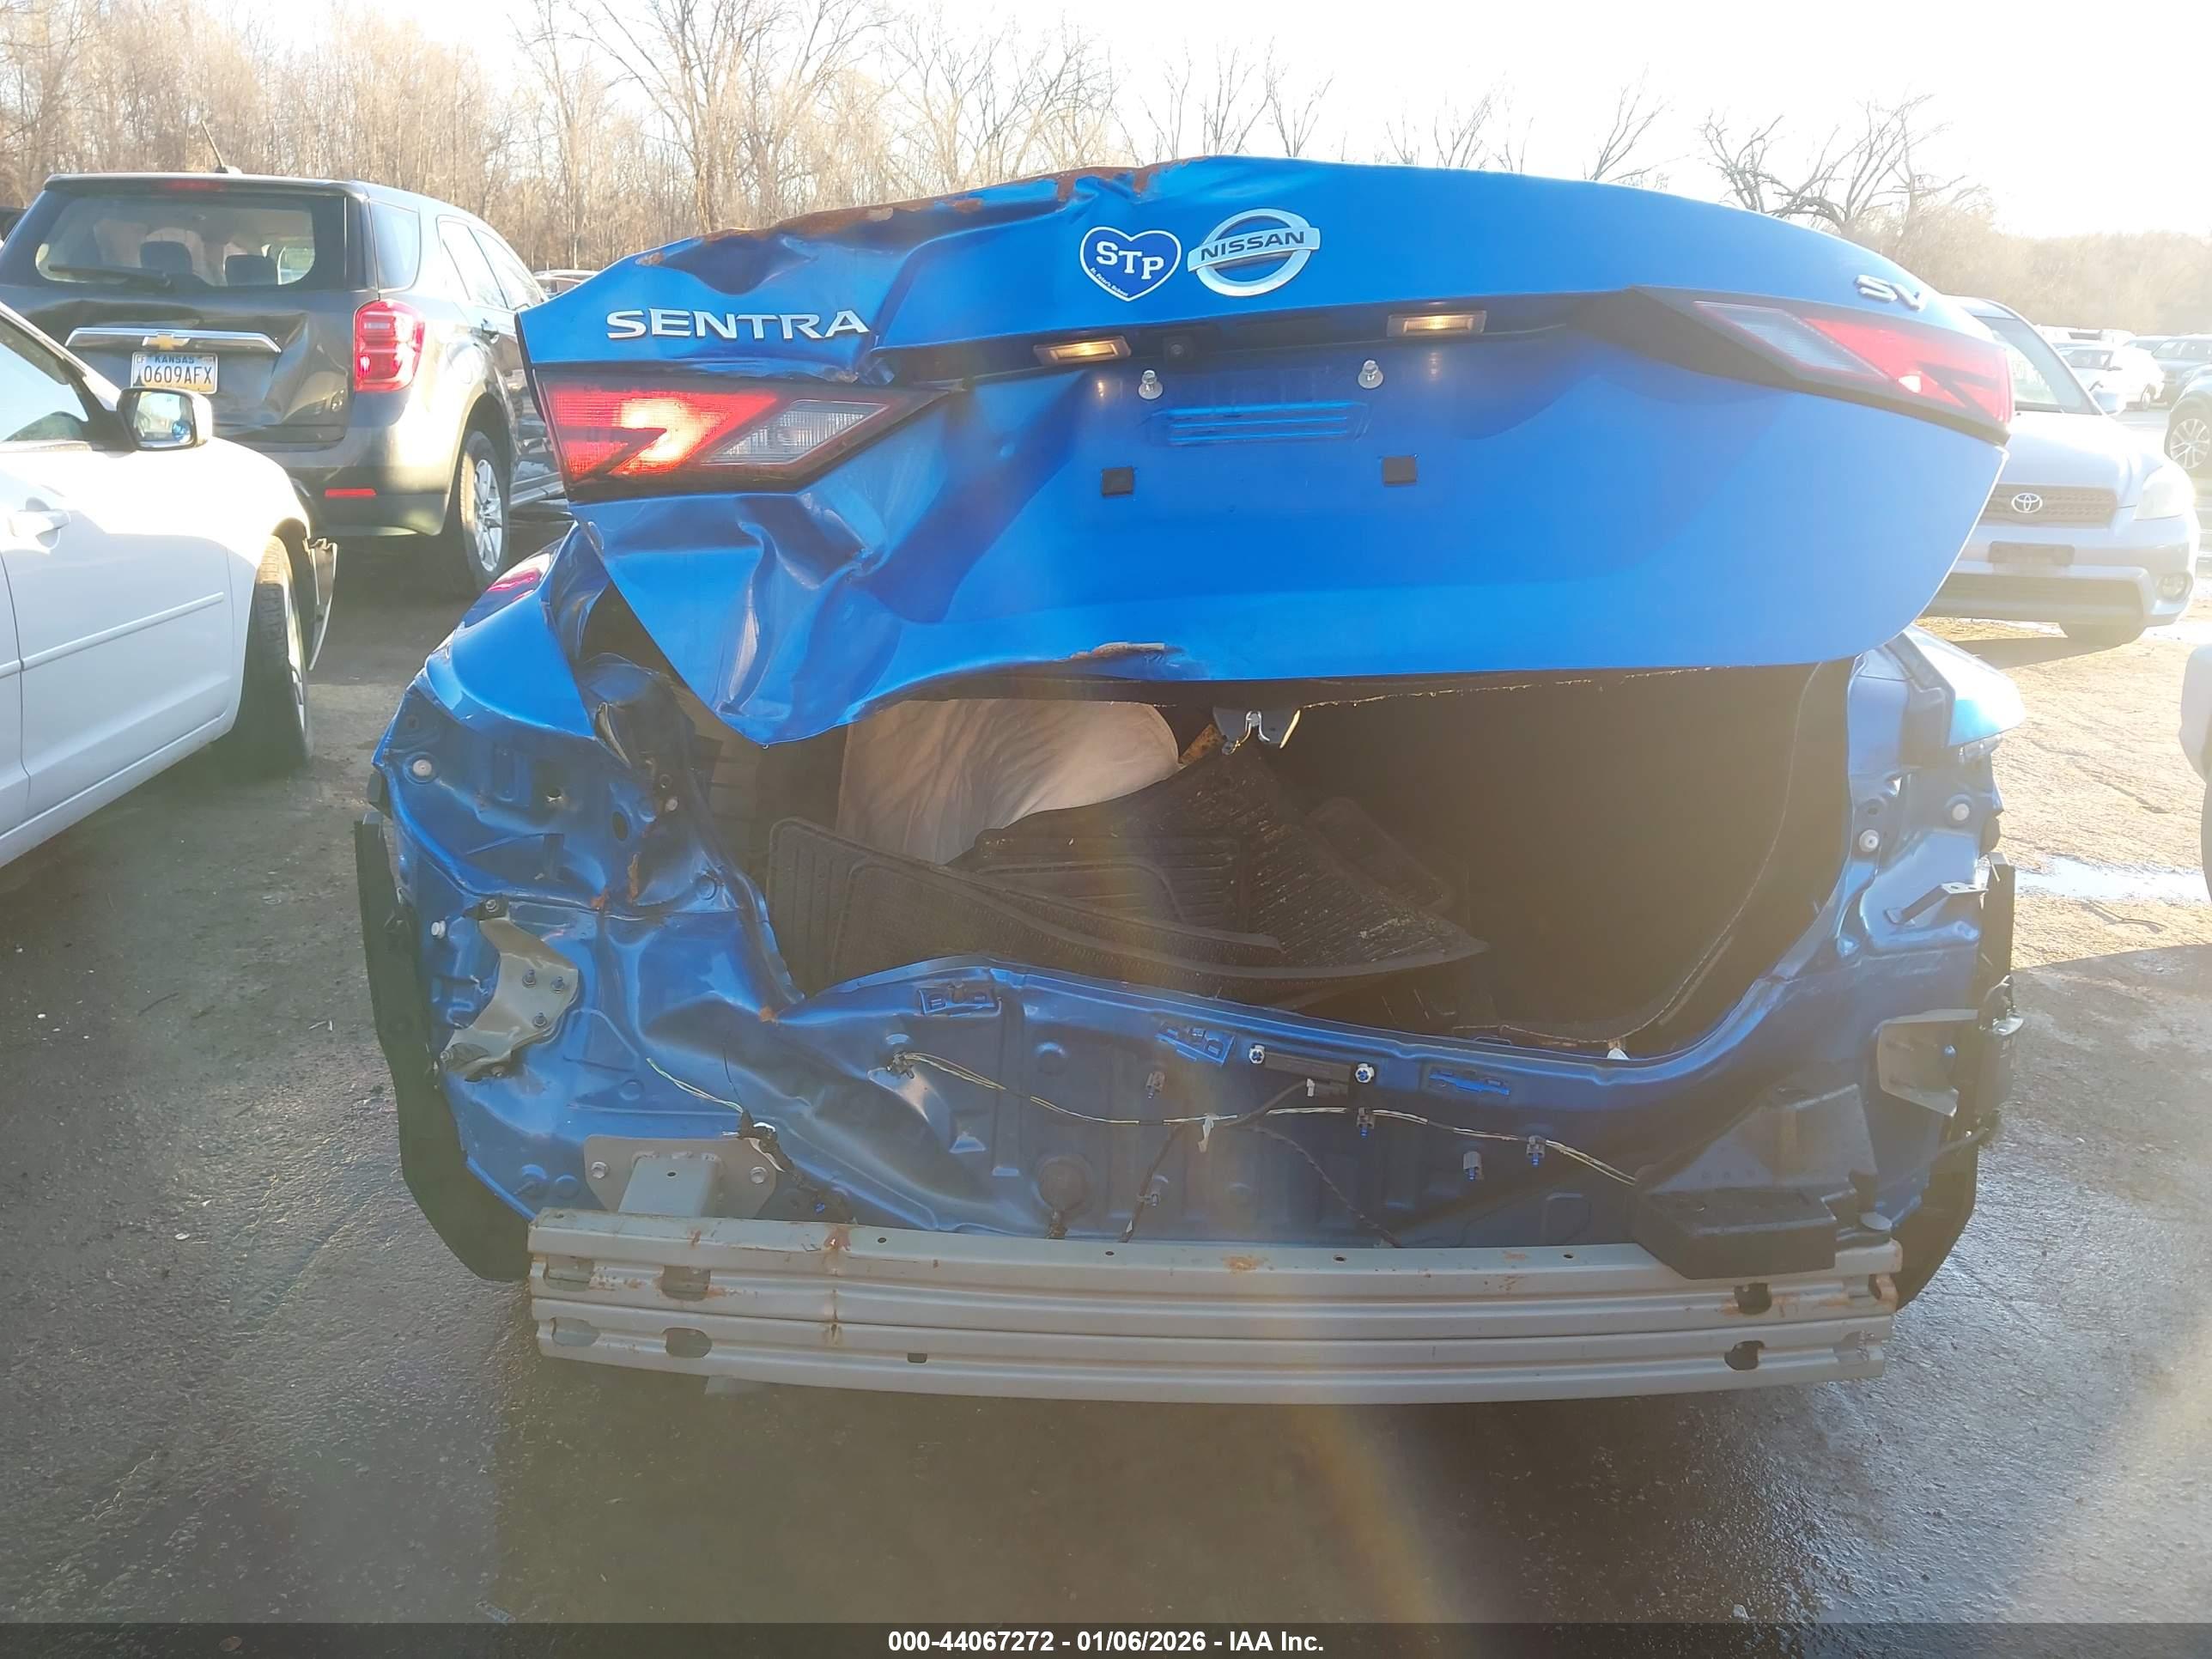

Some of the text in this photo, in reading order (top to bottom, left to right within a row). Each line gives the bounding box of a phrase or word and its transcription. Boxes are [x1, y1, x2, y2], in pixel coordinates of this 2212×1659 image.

[1096, 240, 1164, 280] STP
[1200, 231, 1304, 262] NISSAN
[1854, 274, 1926, 312] SV
[606, 308, 870, 339] SENTRA
[144, 365, 212, 384] 0609AFX
[155, 355, 194, 364] KANSAS
